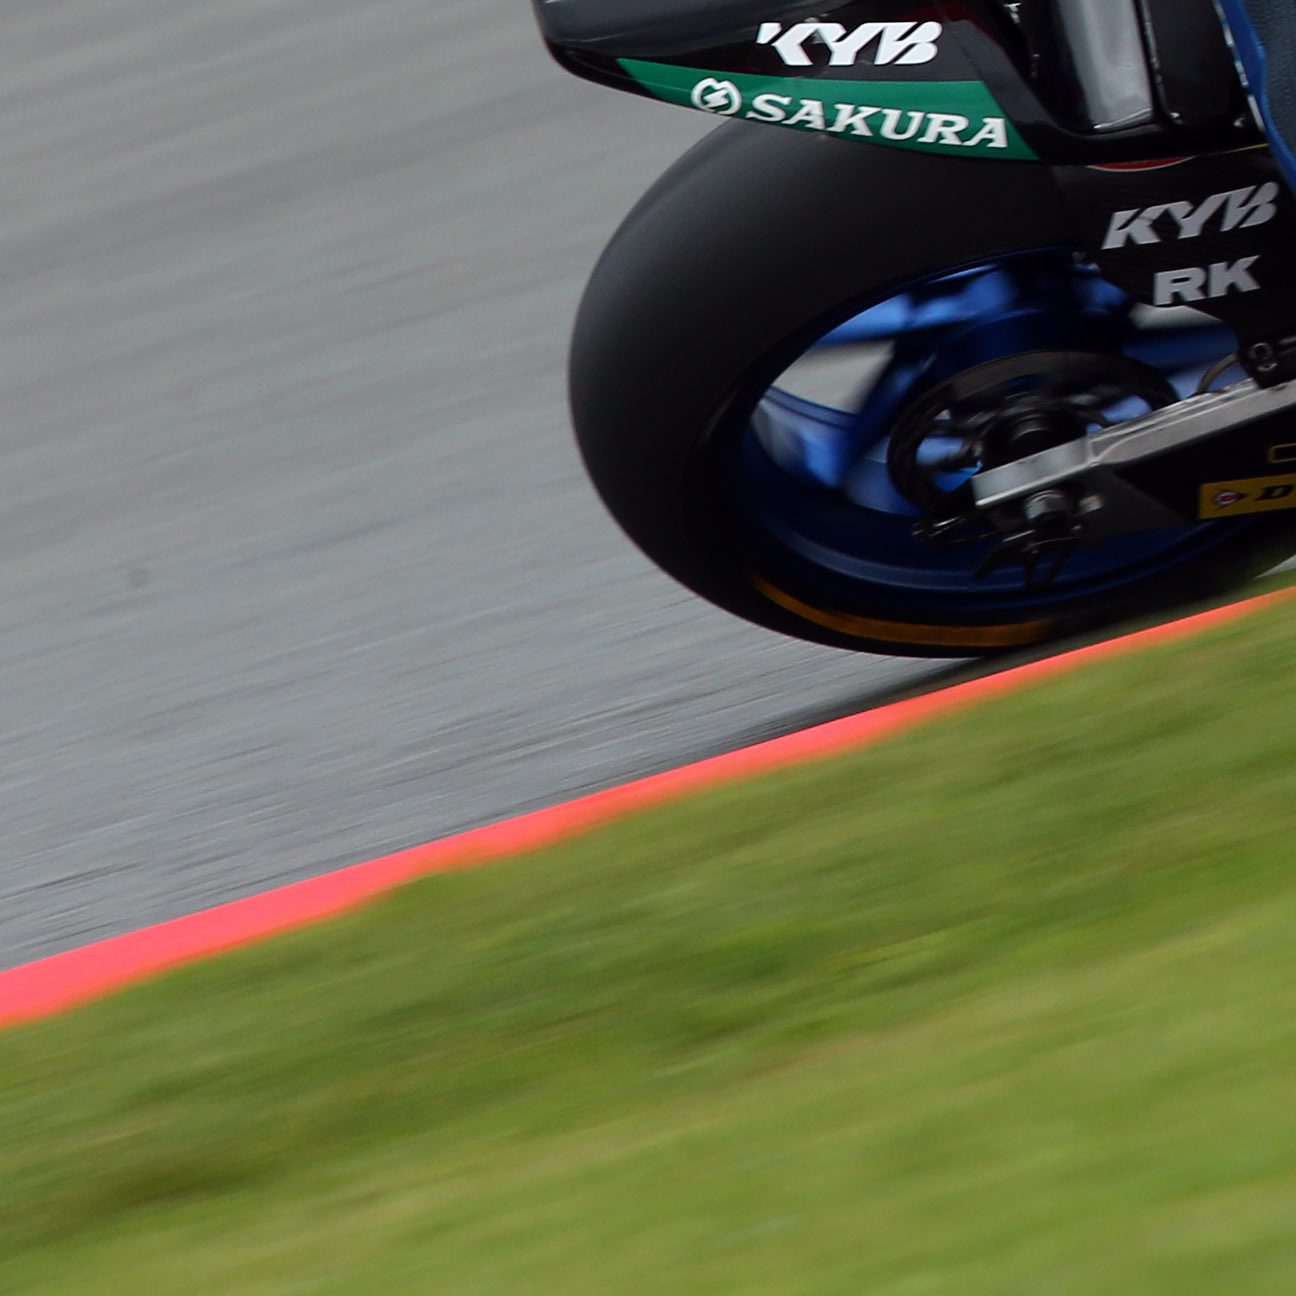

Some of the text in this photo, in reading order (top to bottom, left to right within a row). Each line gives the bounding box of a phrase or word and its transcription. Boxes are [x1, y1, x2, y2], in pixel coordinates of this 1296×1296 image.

[756, 20, 943, 66] KYB
[745, 92, 1009, 149] SAKURA
[1101, 181, 1280, 250] KYB
[1153, 255, 1261, 305] RK
